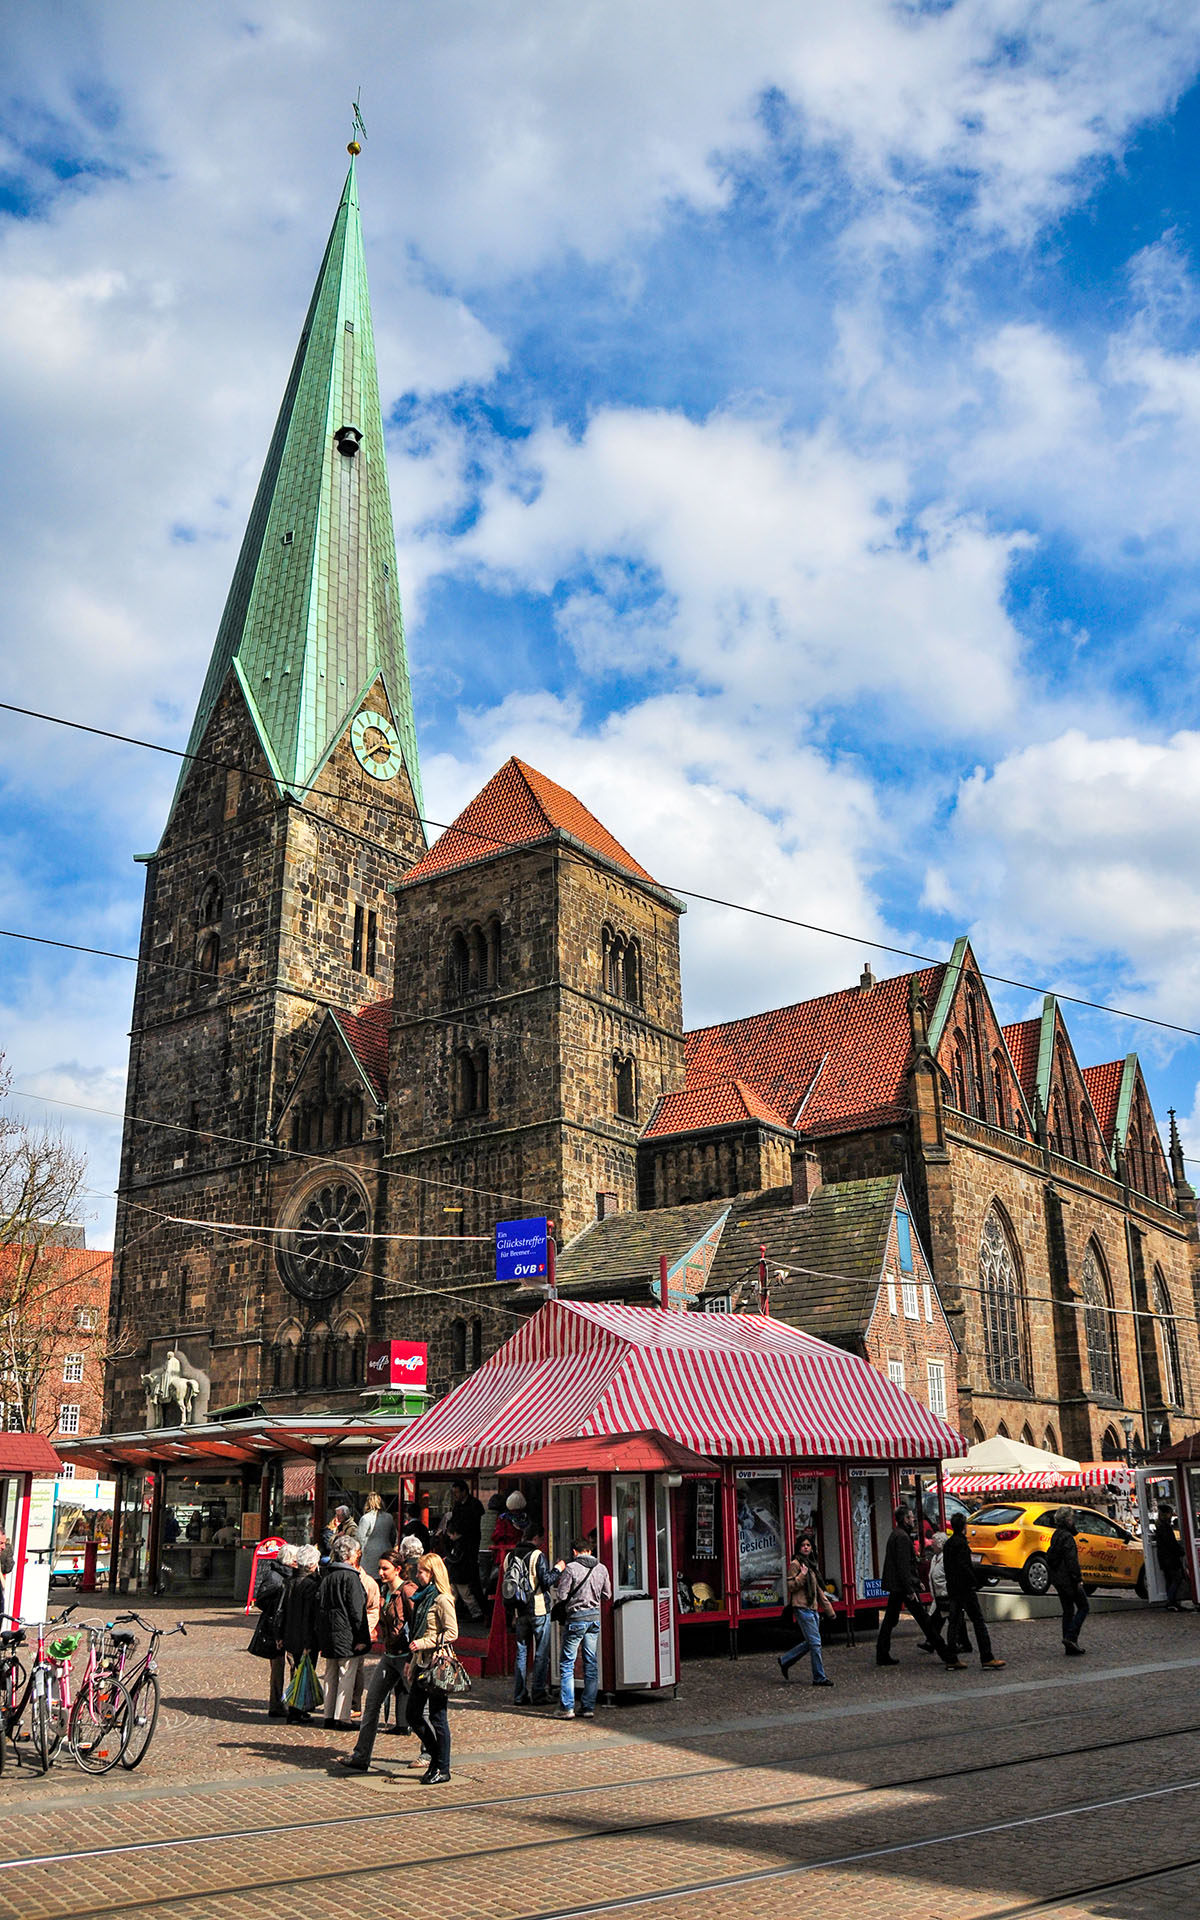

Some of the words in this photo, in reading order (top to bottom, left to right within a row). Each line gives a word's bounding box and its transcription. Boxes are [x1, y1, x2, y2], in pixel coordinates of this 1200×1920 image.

[497, 1235, 546, 1250] Glückstreffer
[500, 1250, 509, 1258] für
[514, 1264, 537, 1276] ÖVB
[738, 1470, 751, 1478] ÖVB
[740, 1535, 777, 1554] Gesicht!
[1087, 1546, 1118, 1563] Auftritt
